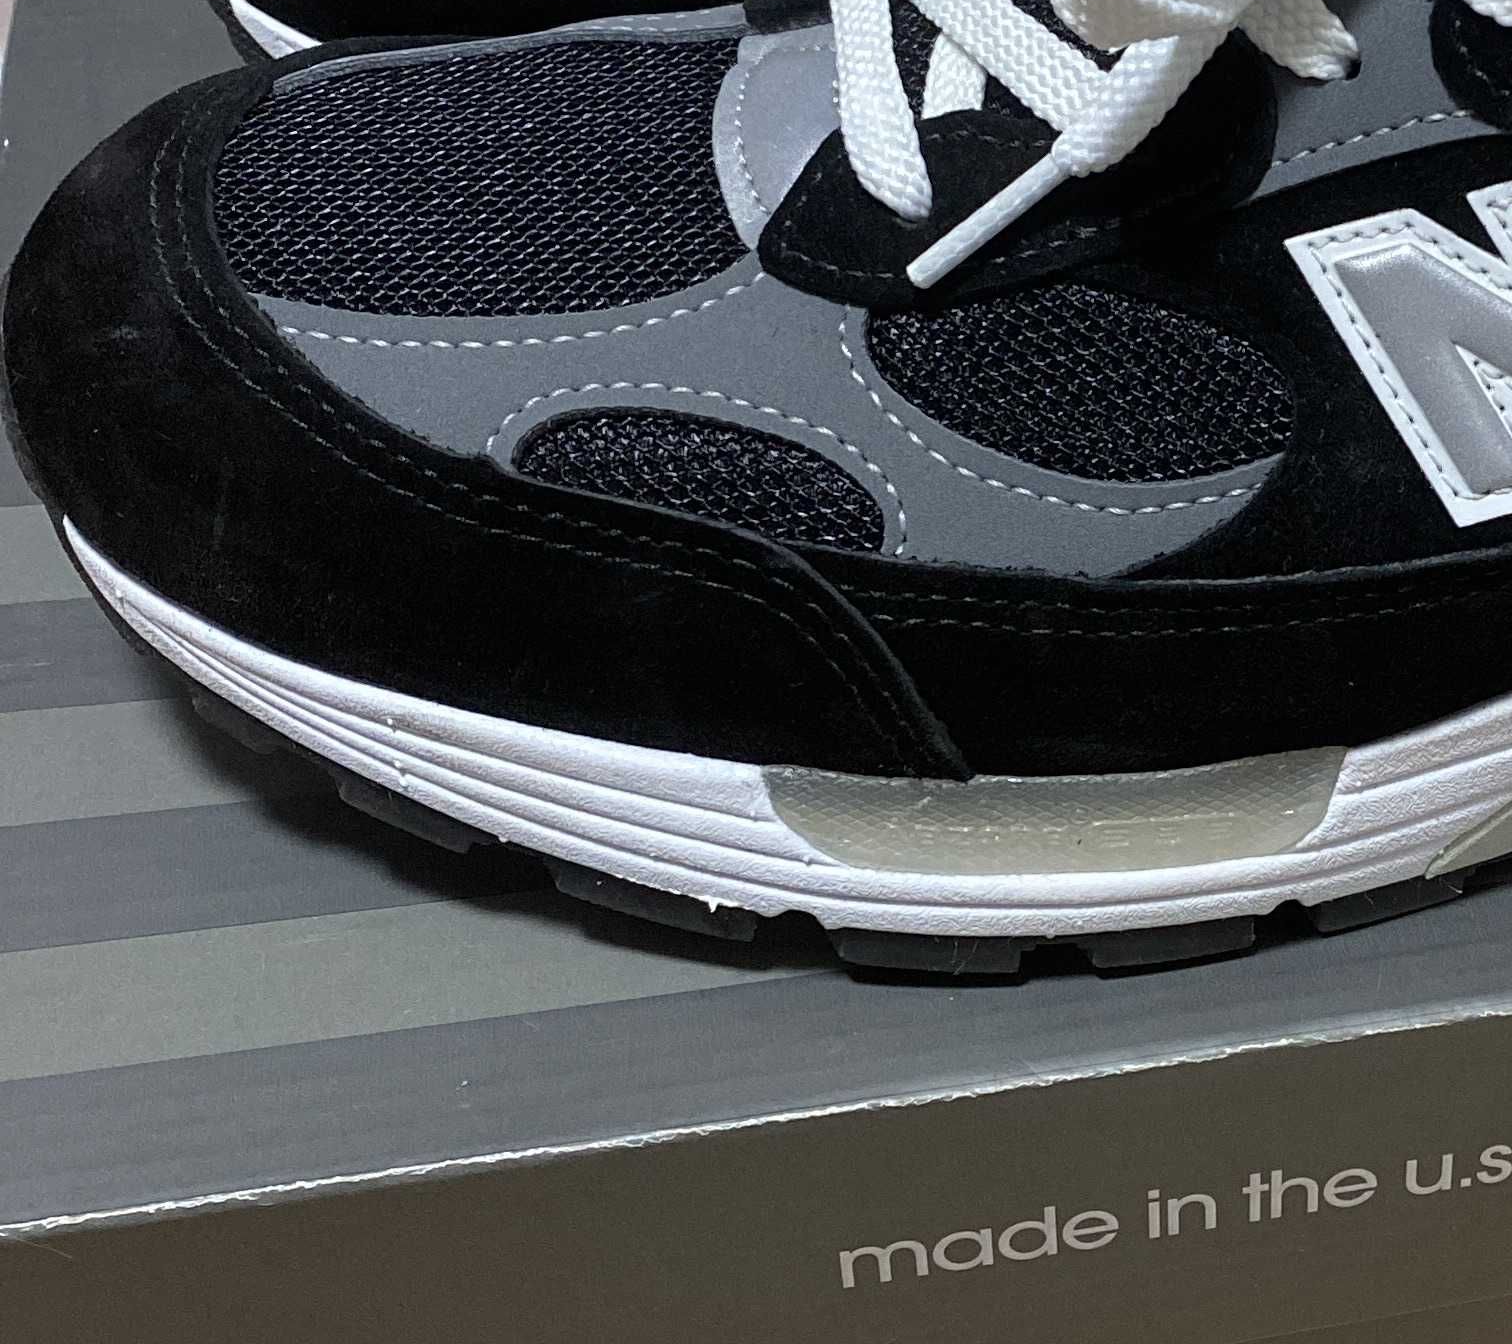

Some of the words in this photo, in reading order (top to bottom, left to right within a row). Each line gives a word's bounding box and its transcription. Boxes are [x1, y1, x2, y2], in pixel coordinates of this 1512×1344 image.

[838, 1205, 1120, 1289] made
[1146, 1188, 1218, 1240] in
[1241, 1168, 1379, 1223] the
